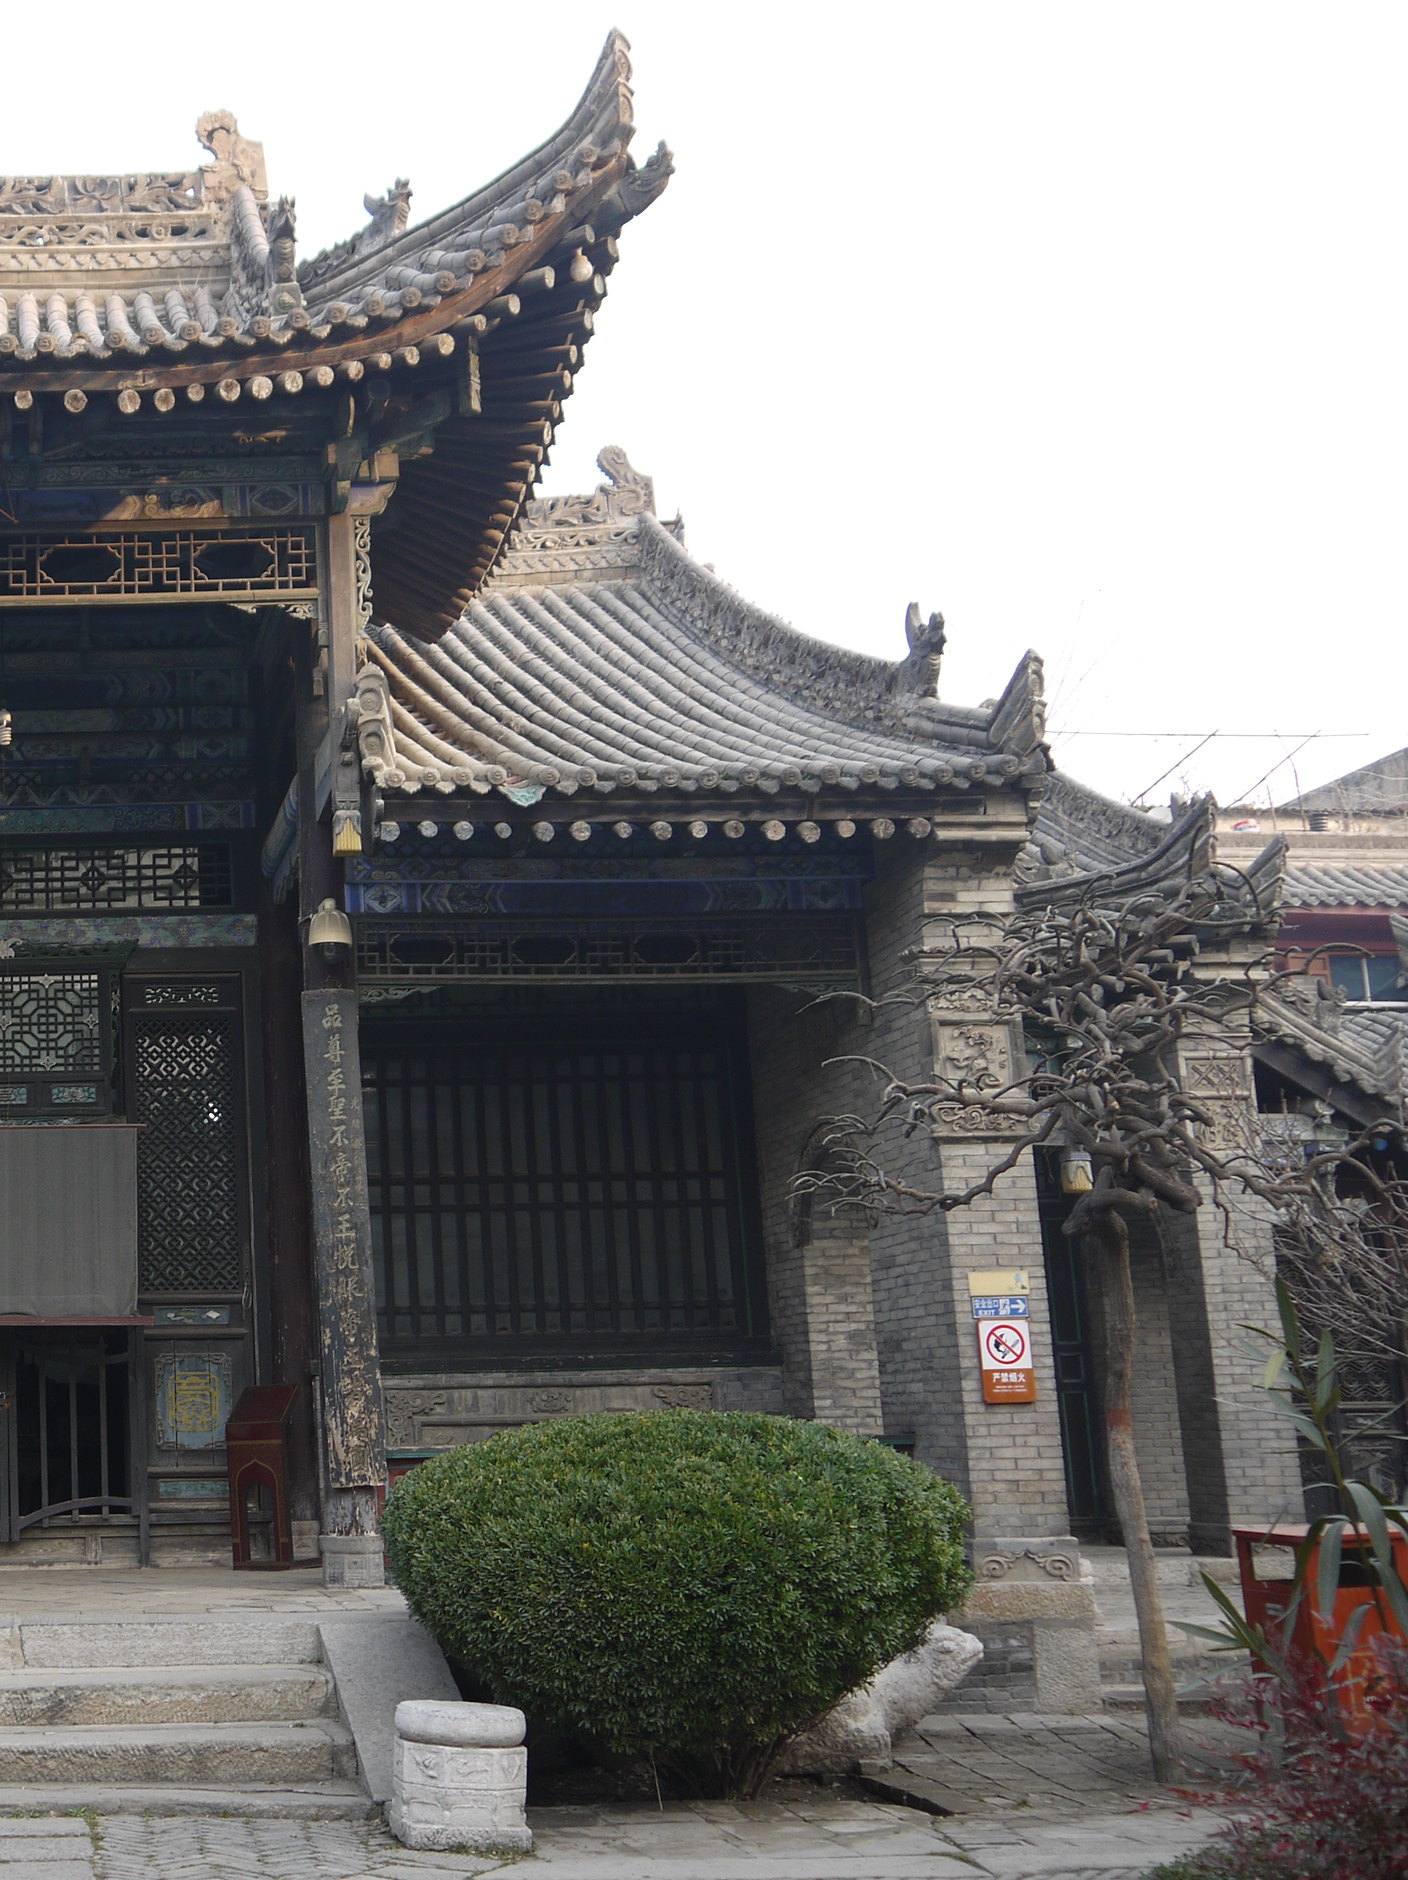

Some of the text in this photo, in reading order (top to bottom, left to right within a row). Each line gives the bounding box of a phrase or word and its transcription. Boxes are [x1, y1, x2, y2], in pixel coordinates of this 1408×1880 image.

[974, 1299, 998, 1308] 安全出口
[992, 1372, 1026, 1383] 严禁烟火
